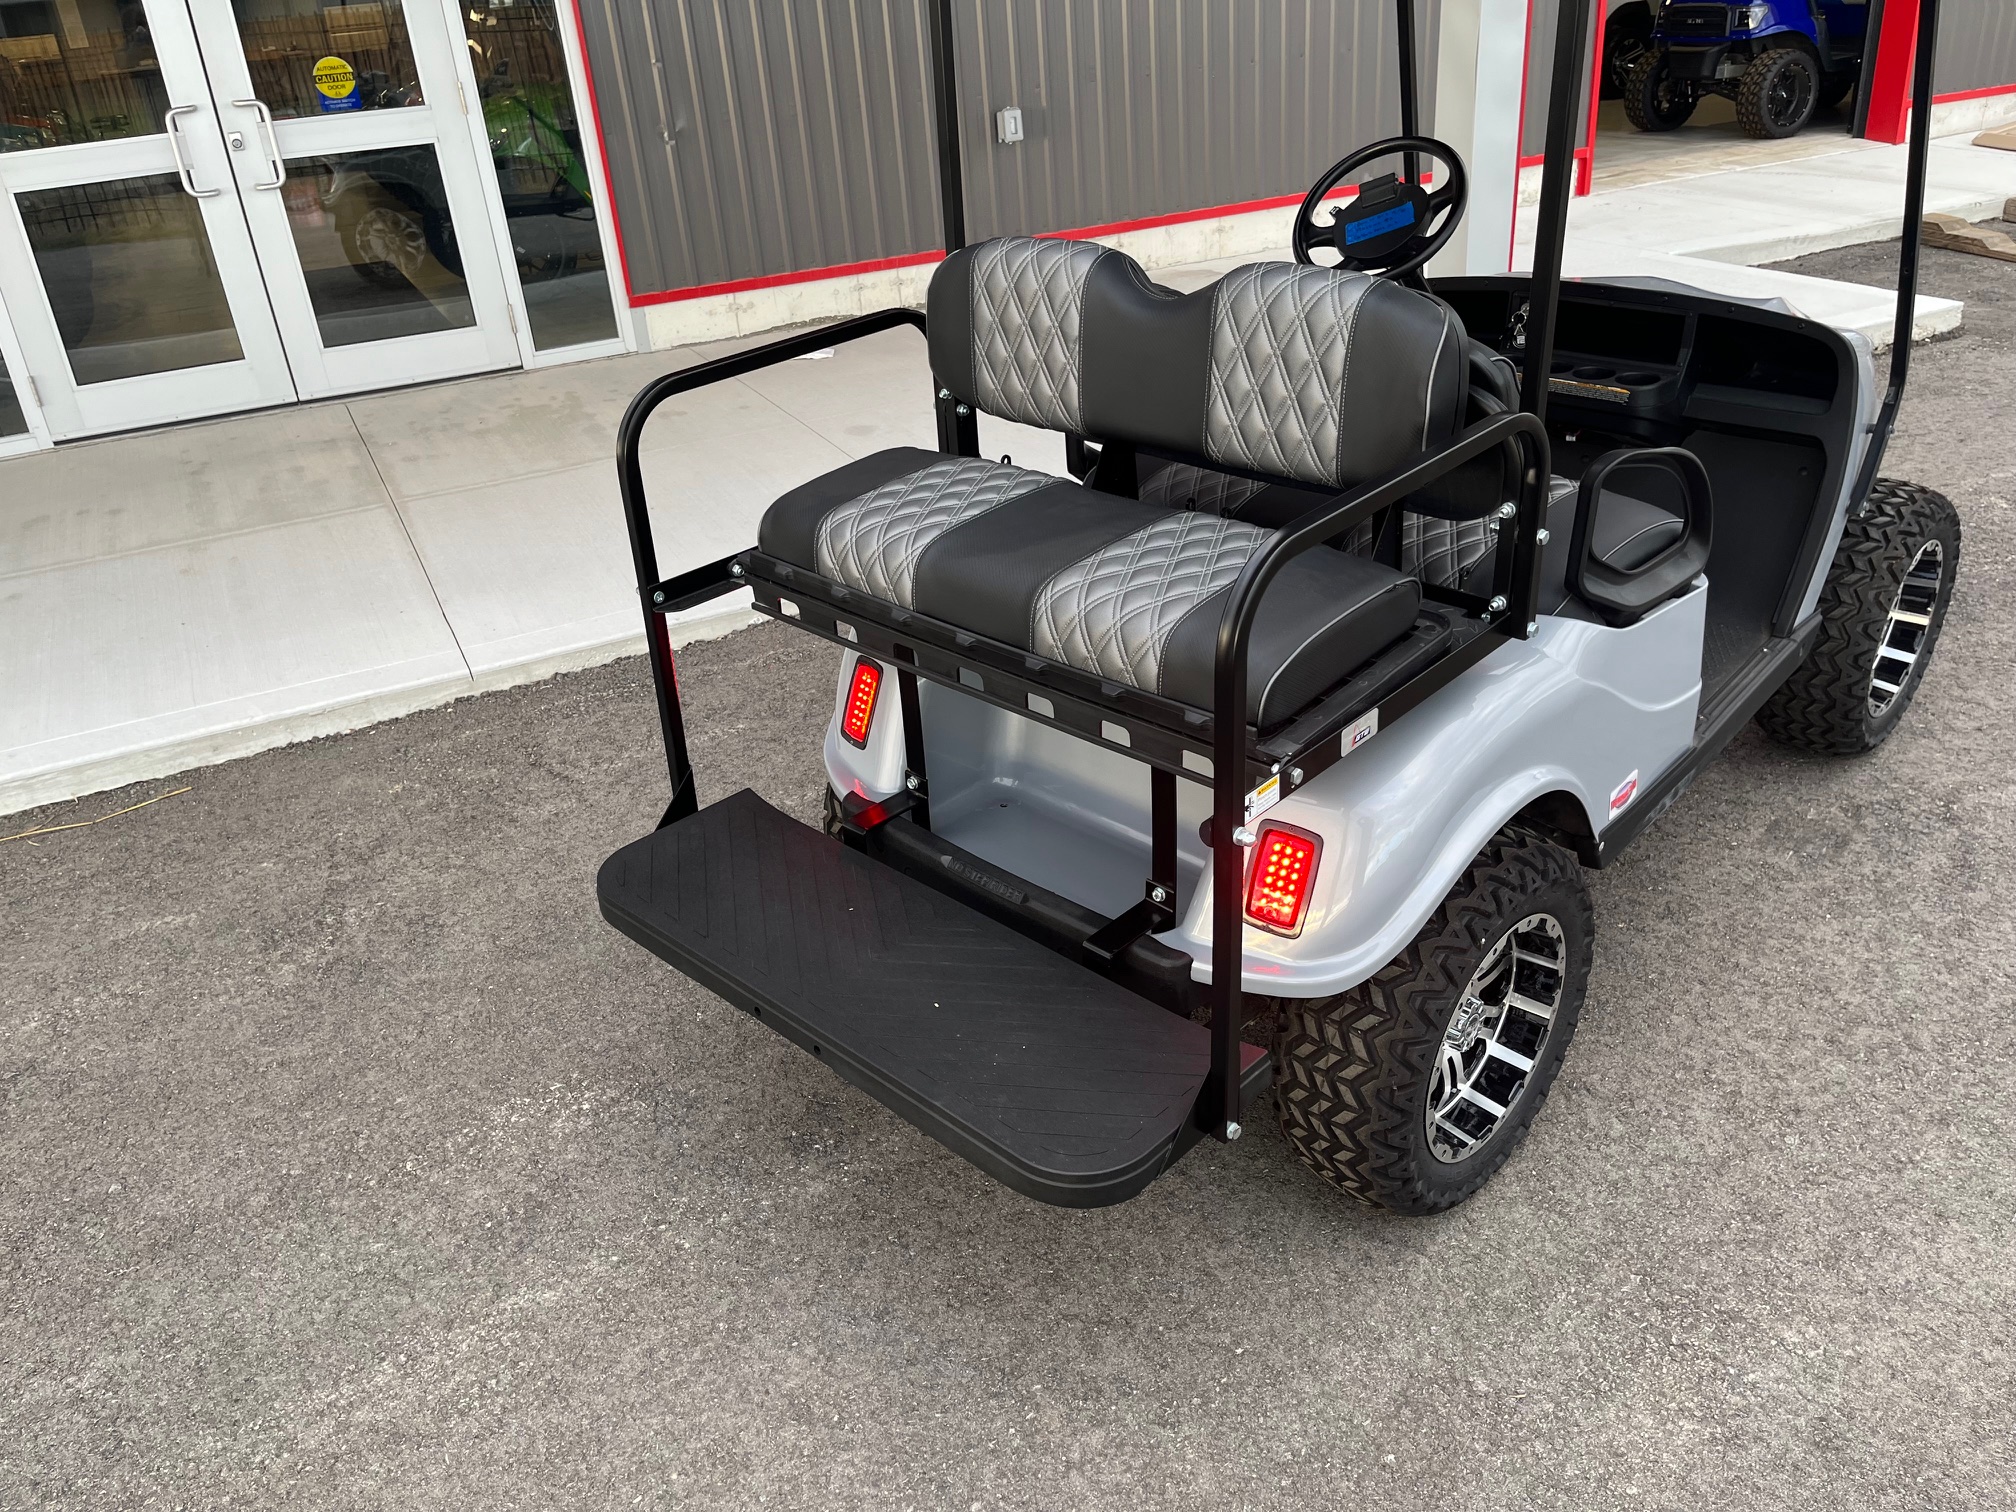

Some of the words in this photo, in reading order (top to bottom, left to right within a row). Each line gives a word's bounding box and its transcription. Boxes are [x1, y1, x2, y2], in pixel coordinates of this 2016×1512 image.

[316, 64, 347, 72] AUTOMATIC
[315, 73, 353, 83] CAUTION
[948, 858, 964, 872] NO
